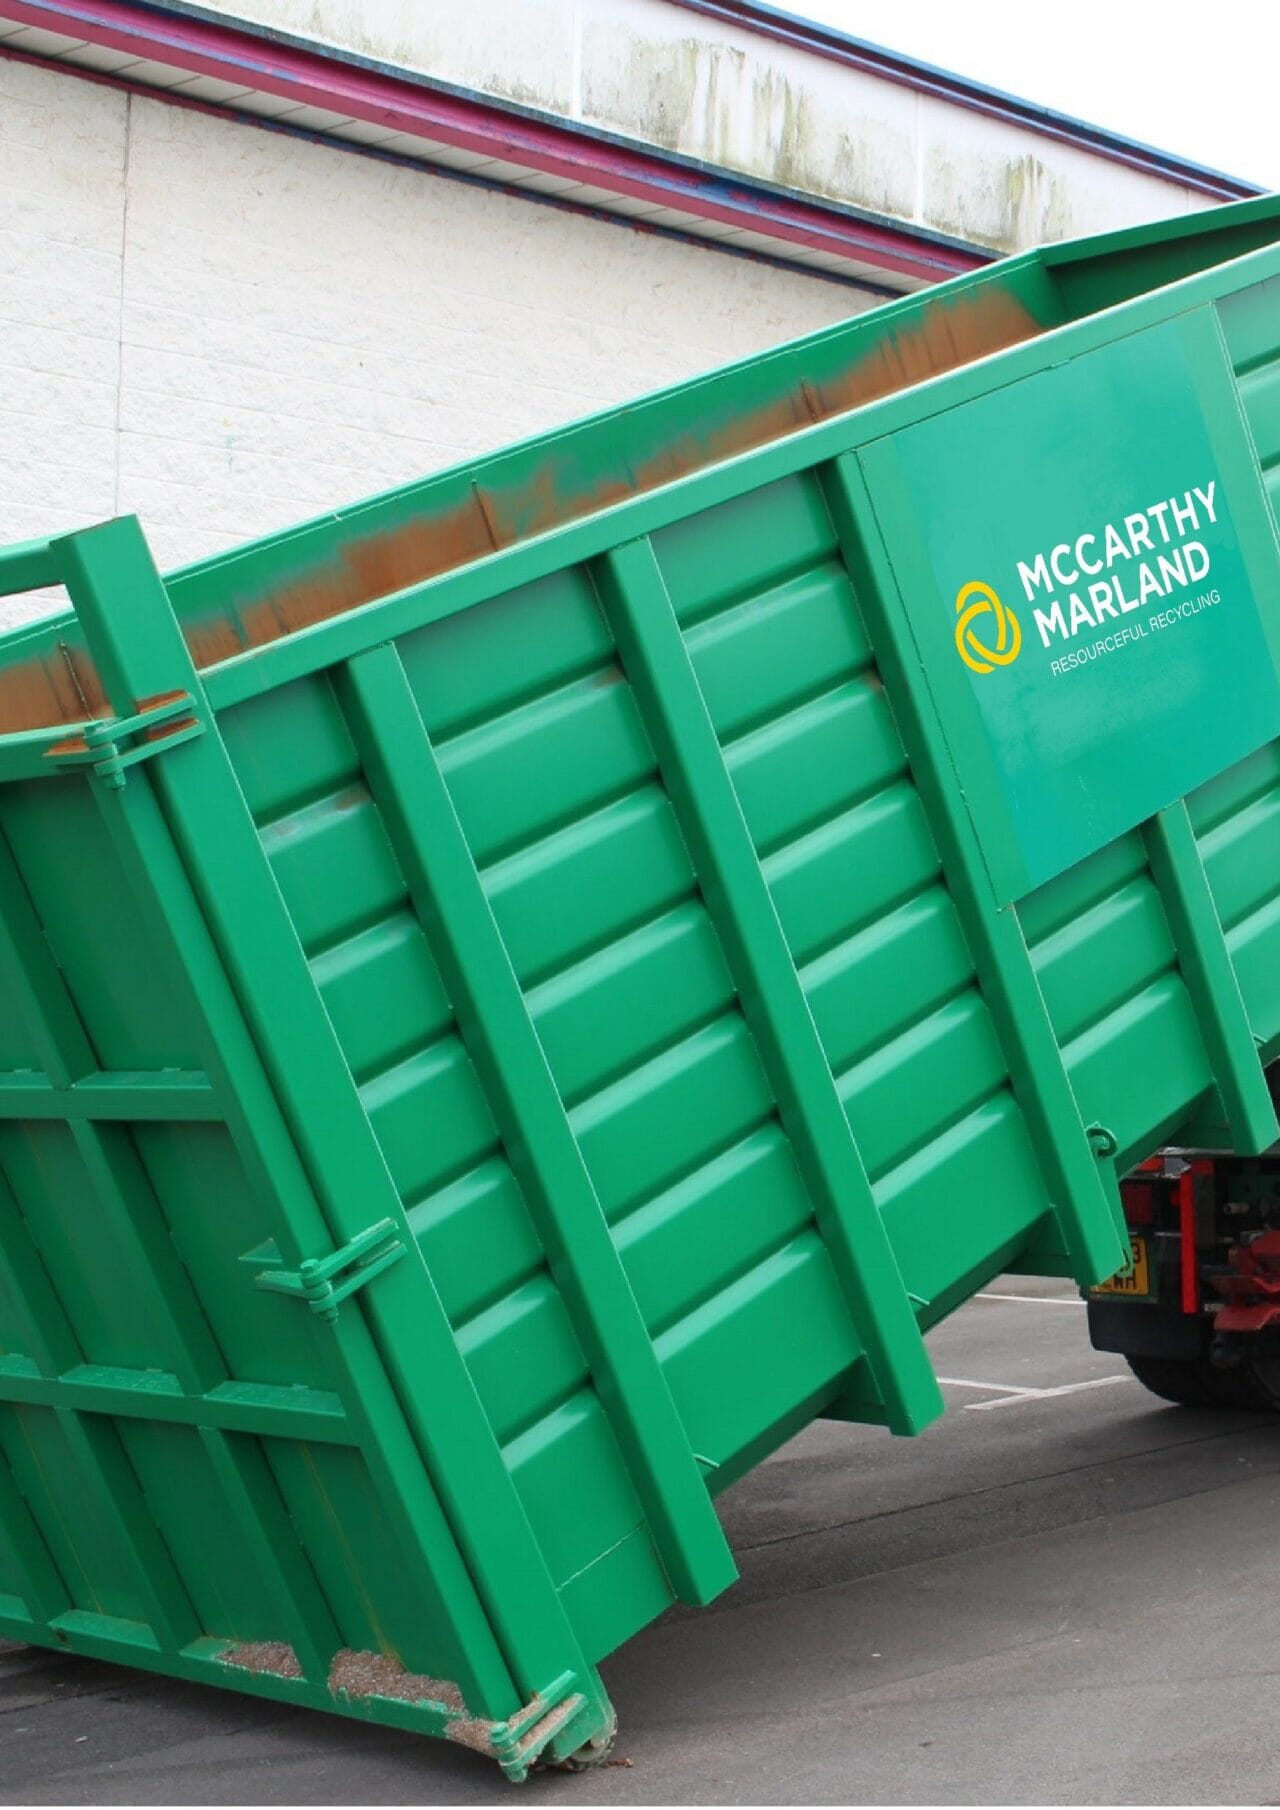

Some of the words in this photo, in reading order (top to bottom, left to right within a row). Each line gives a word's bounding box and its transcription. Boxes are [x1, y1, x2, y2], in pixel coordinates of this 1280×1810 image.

[1016, 480, 1217, 602] MCCARTHY
[1032, 541, 1210, 649] MARLAND
[1050, 623, 1149, 676] RESOURCEFUL
[1149, 589, 1221, 632] RECYCLING
